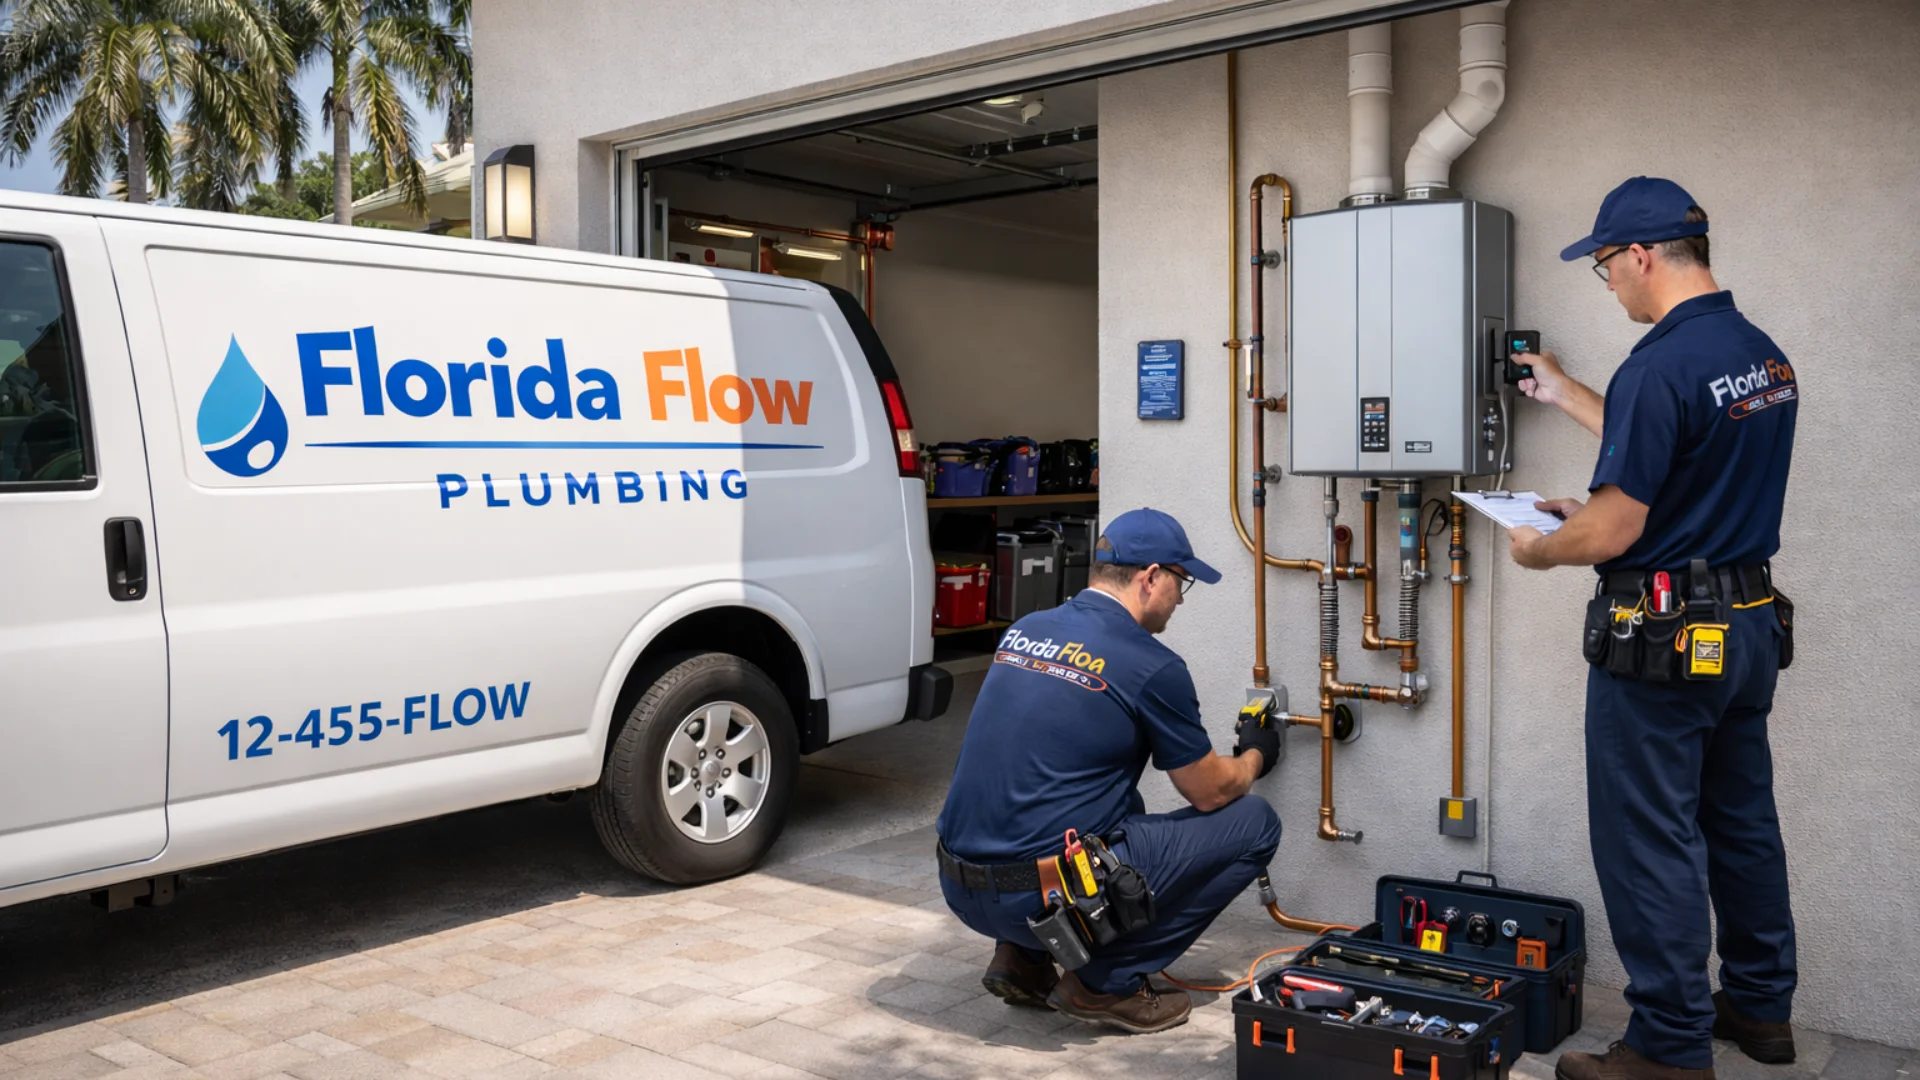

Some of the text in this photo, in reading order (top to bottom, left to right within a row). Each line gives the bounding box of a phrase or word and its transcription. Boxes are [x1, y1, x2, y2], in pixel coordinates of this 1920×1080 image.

[295, 325, 814, 426] Florida Flow
[436, 469, 749, 509] PLUMBING
[217, 681, 532, 761] 12-455-FLOW
